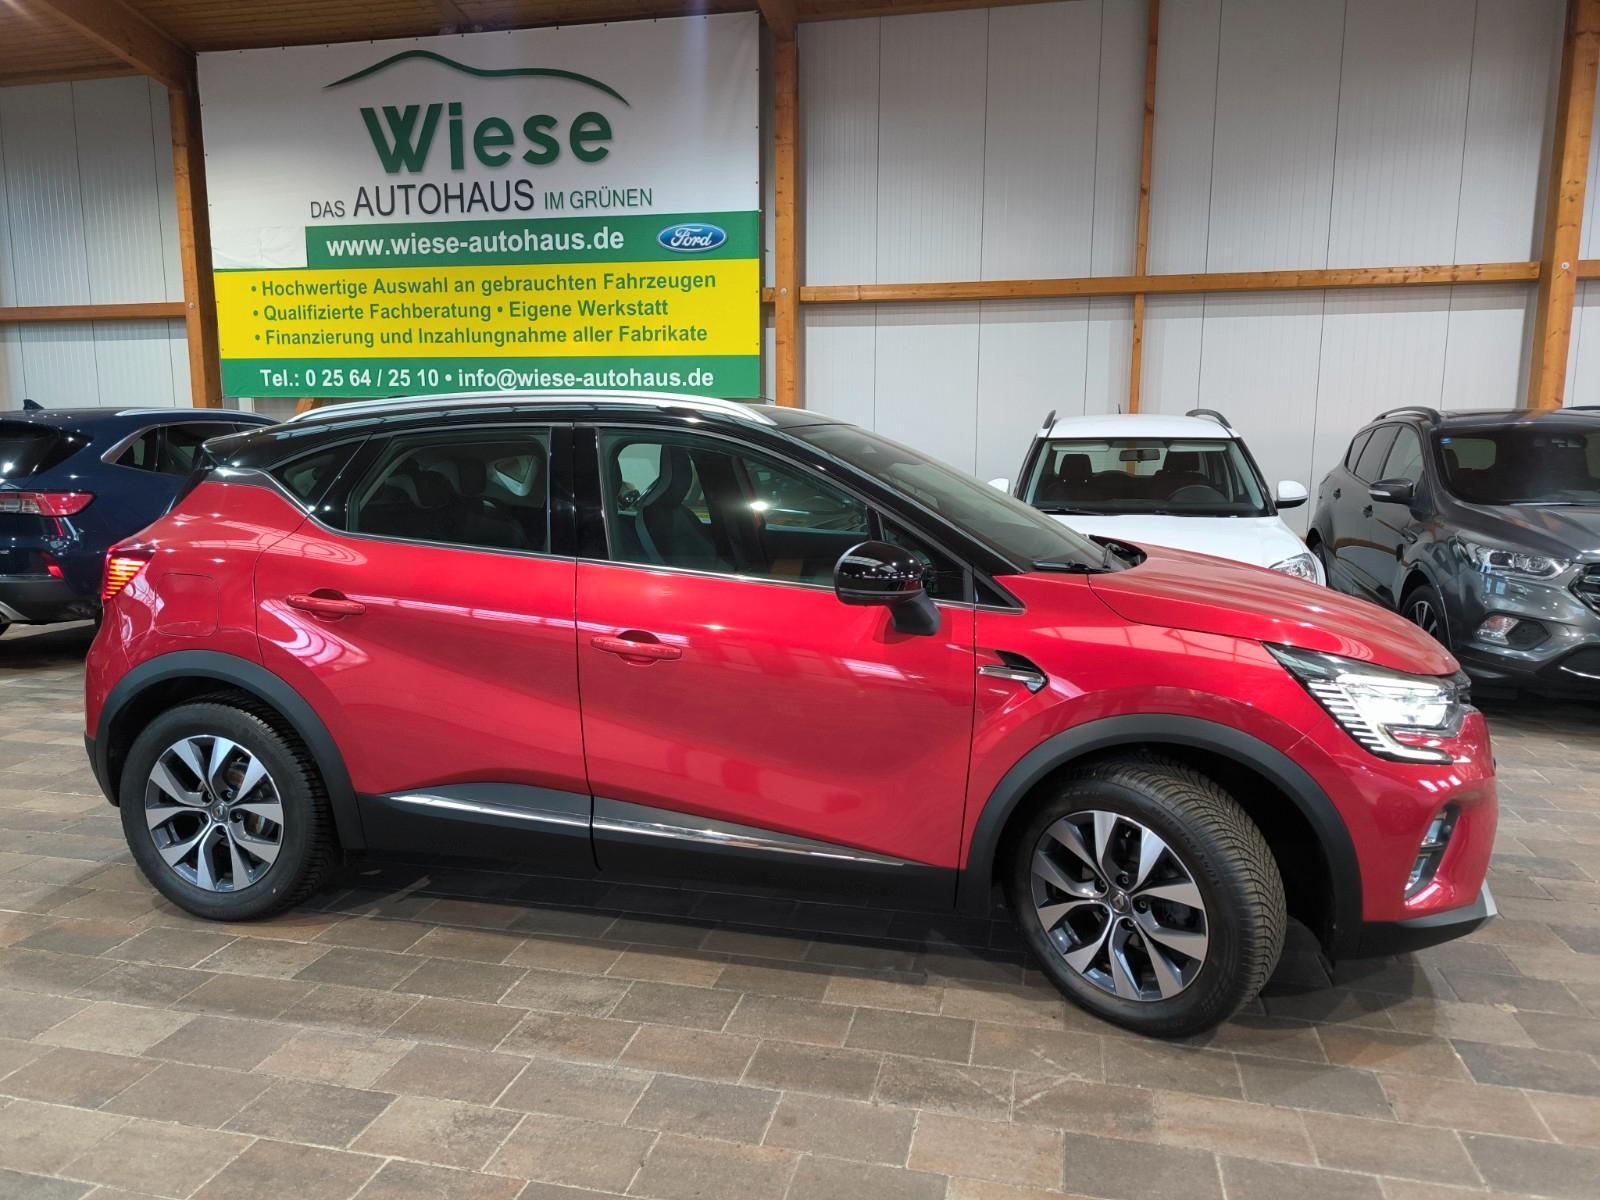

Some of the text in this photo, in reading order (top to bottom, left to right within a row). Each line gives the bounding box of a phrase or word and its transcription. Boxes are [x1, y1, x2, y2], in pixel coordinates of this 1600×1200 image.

[360, 102, 612, 173] Wiese
[310, 179, 652, 218] DAS AUTOHAUS IM GRÜNEN
[326, 226, 625, 256] www.wiese-autohaus.de
[670, 227, 713, 247] Ford
[262, 272, 716, 298] Hochwertige Auswahl an gebrauchten Fahrzeugen
[263, 299, 669, 321] Qualifizierte Fachberatung Eigene Werkstatt
[266, 325, 708, 348] Finanzierung und Inzahlungnahme aller Fabrikate
[260, 367, 714, 391] Tel.: 0 25 64 / 25 10 info@wiese-autohaus.de
